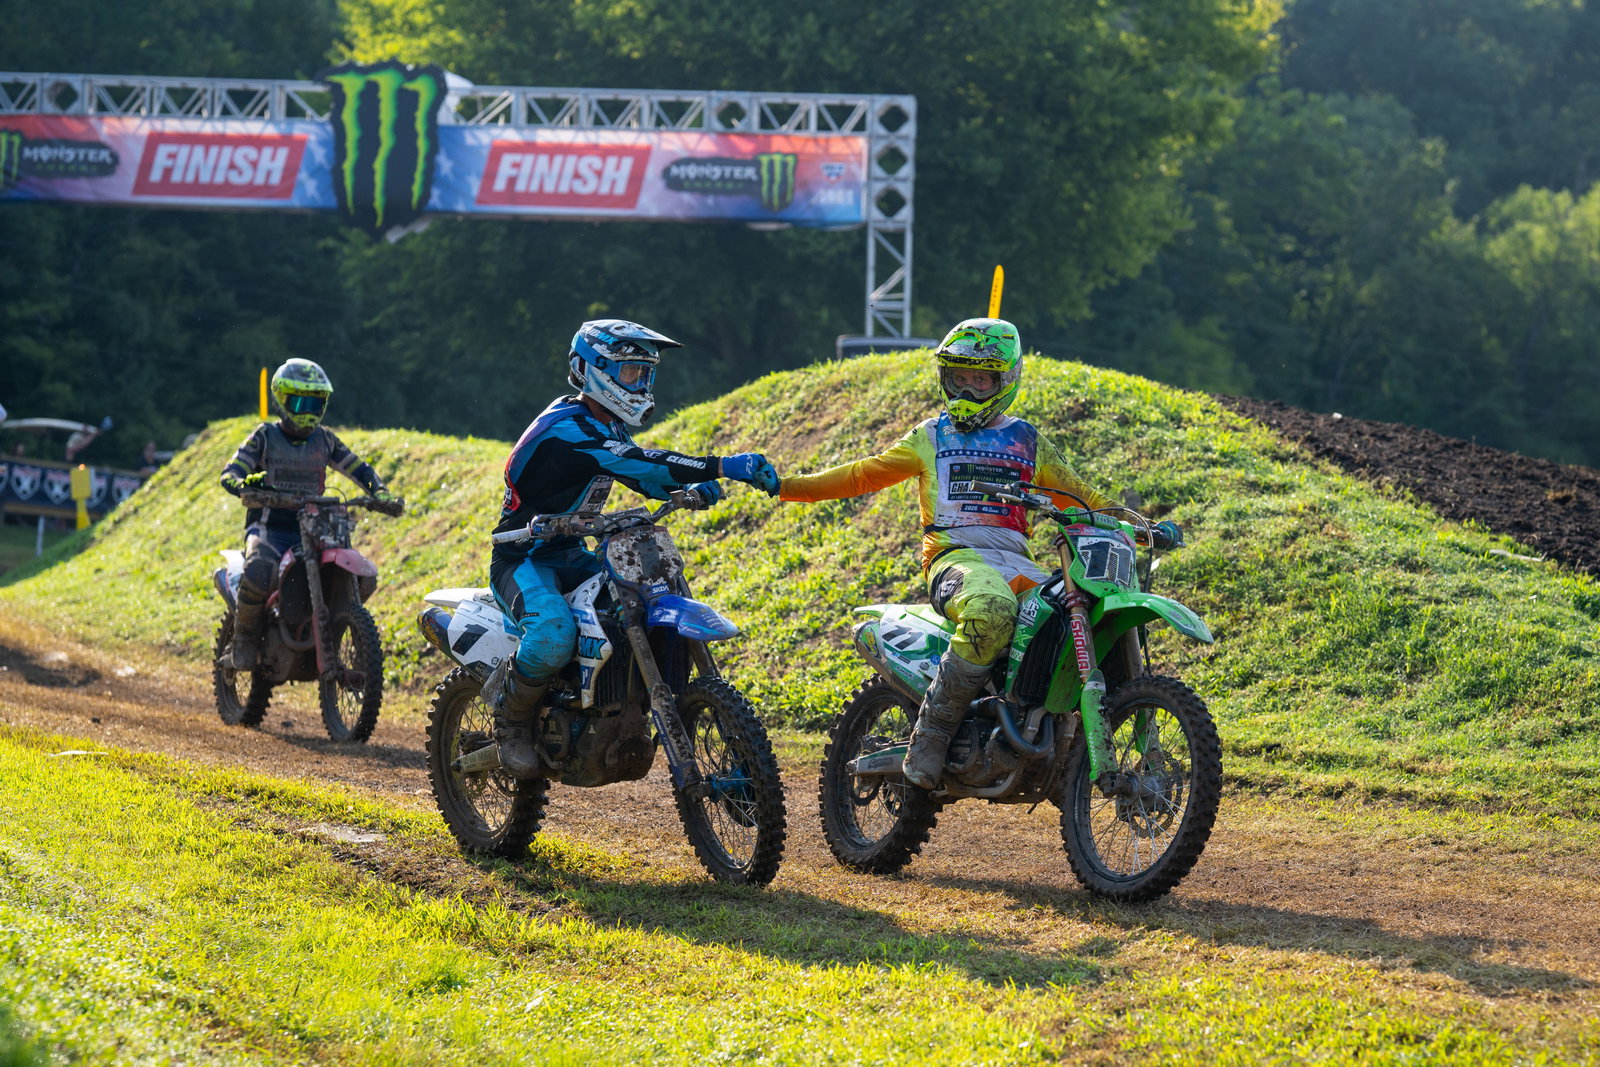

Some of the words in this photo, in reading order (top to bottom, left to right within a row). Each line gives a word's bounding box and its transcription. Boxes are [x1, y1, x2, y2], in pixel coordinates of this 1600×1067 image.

[23, 144, 112, 164] MONSTER
[149, 143, 289, 185] FINISH
[670, 163, 758, 182] MONSTER
[493, 153, 634, 195] FINISH
[1080, 541, 1132, 586] 11
[452, 623, 489, 656] 1
[882, 625, 924, 650] 11
[1070, 619, 1090, 671] SHOWA
